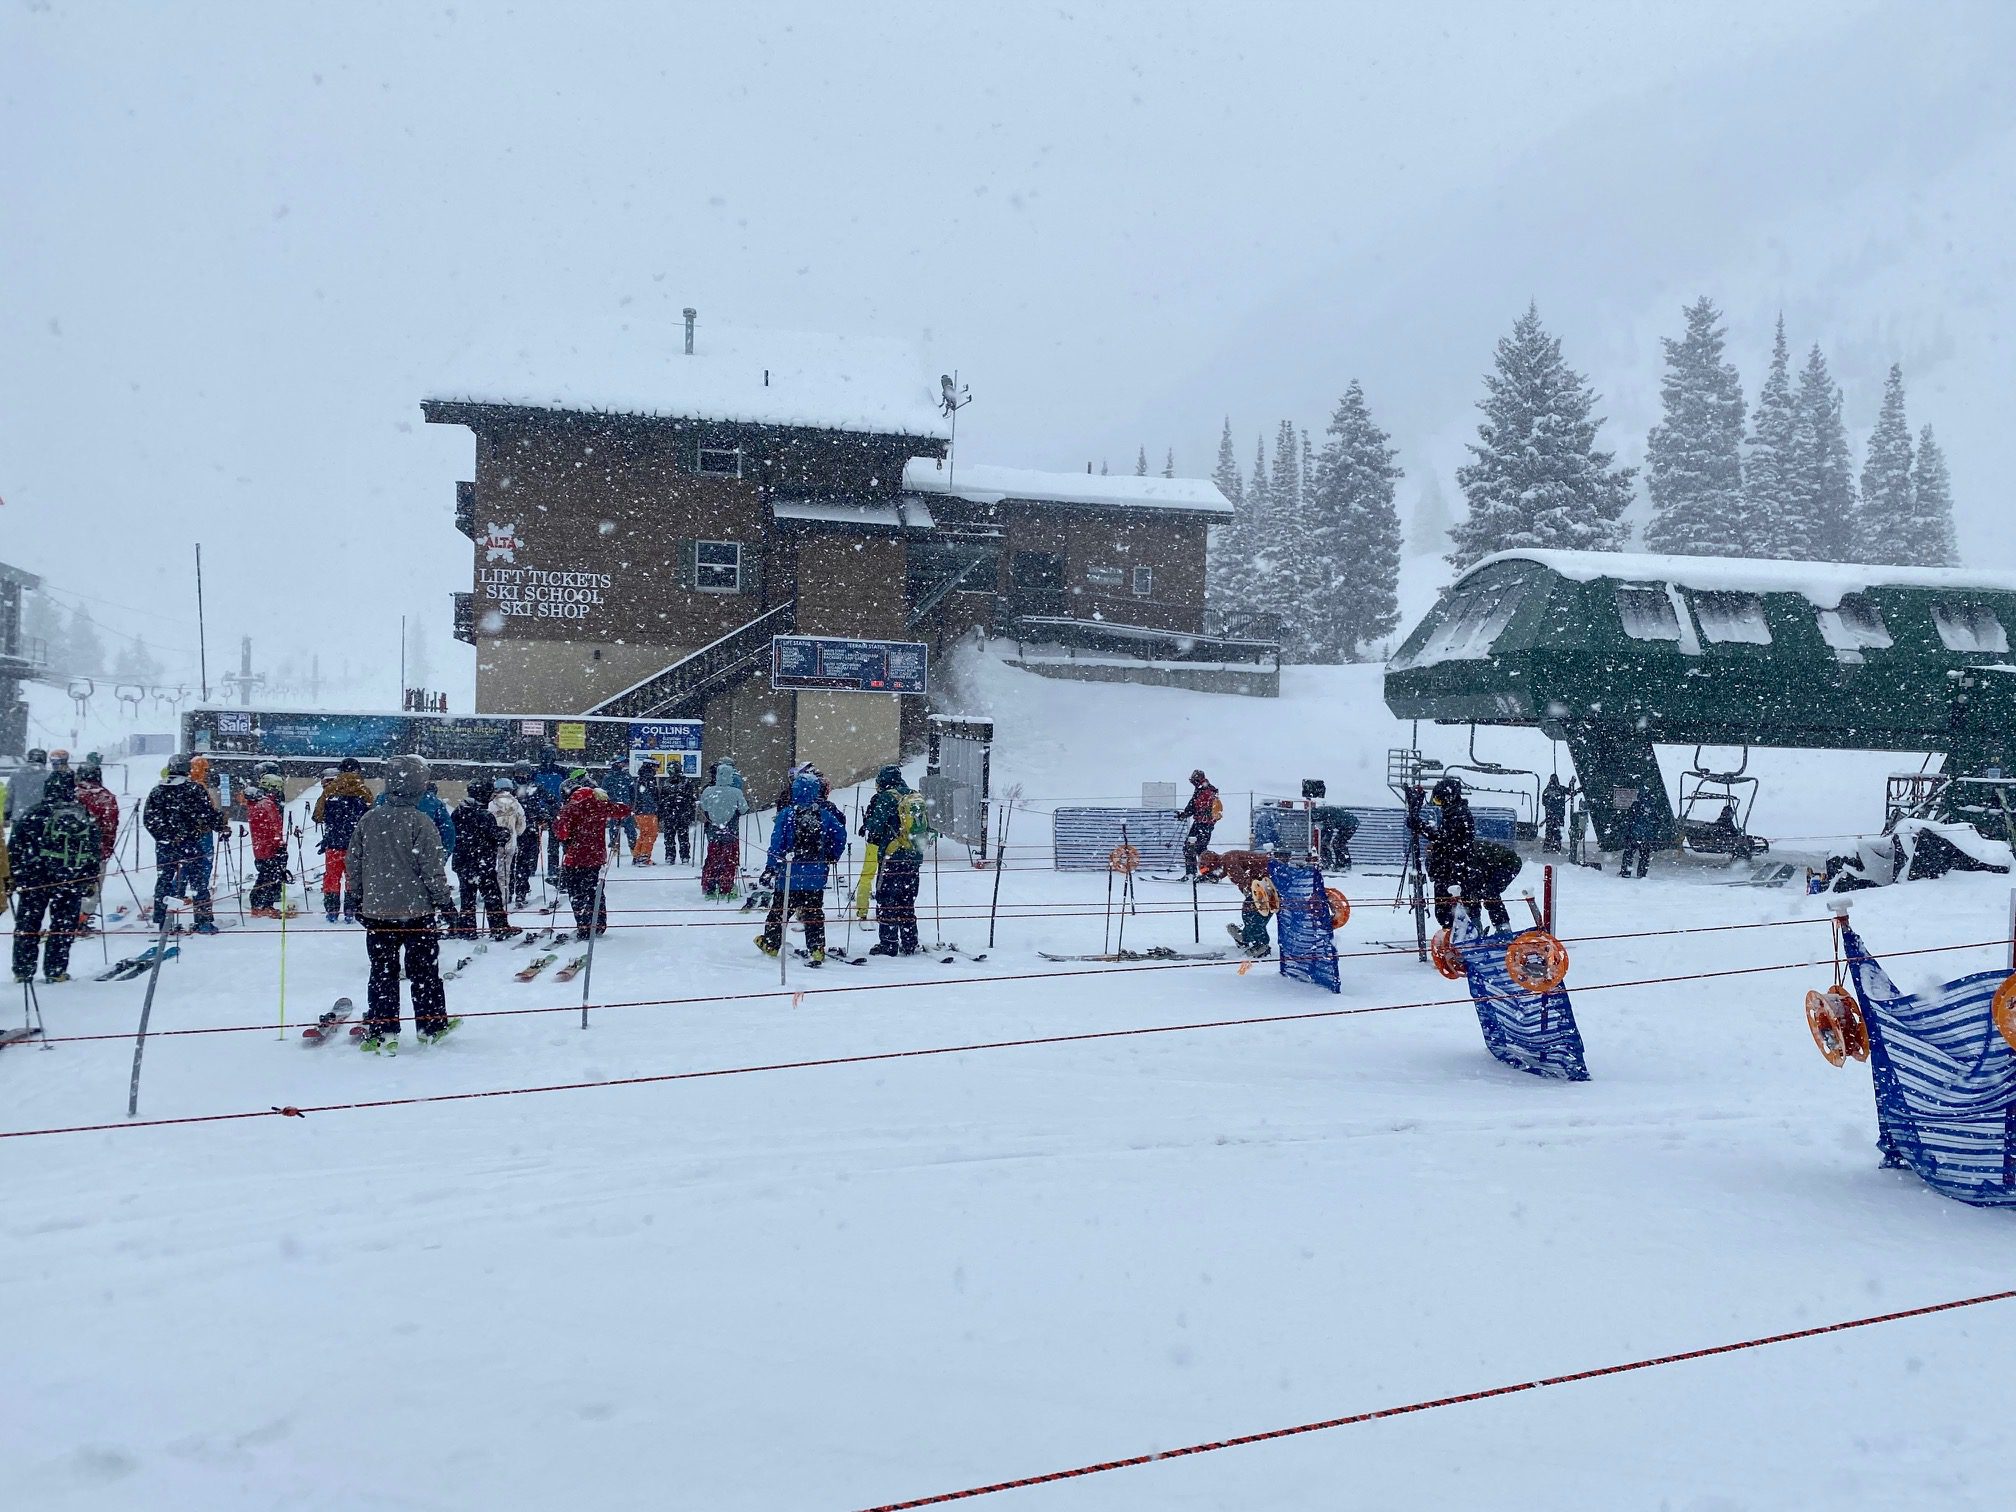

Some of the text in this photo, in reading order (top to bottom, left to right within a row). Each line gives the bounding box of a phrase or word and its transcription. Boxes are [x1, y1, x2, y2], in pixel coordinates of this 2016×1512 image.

[484, 537, 517, 549] ALTA
[479, 569, 611, 589] LIFT TICKETS
[486, 584, 604, 604] SKI SCHOOL
[499, 600, 590, 619] SKI SHOP
[219, 719, 248, 732] Sale
[450, 726, 472, 734] Camp
[641, 725, 690, 736] COLLINS
